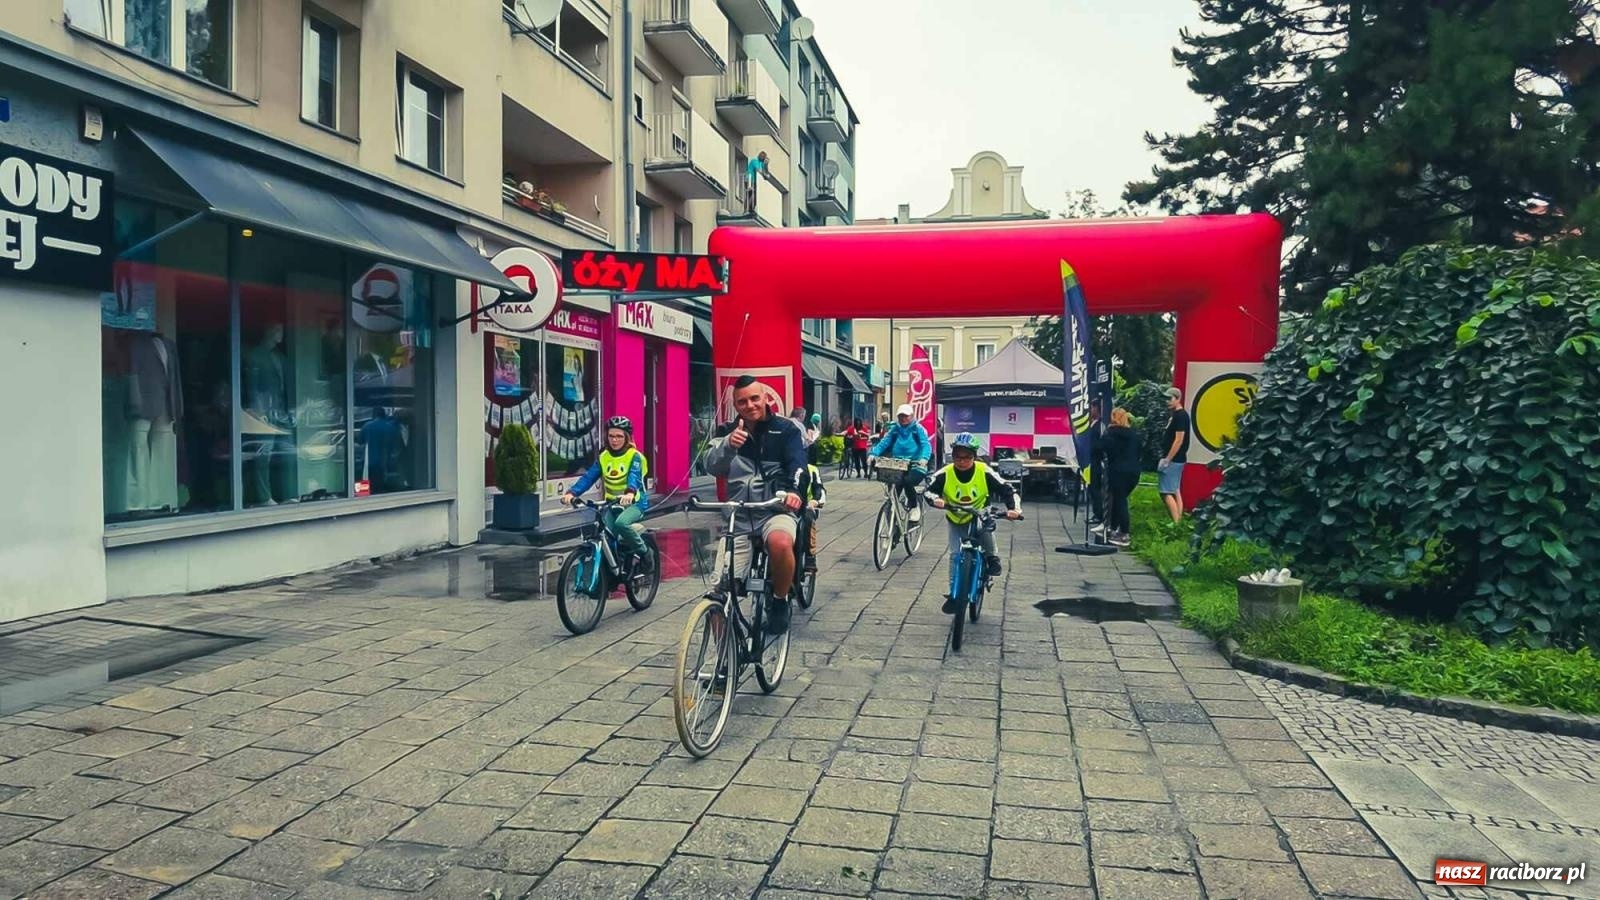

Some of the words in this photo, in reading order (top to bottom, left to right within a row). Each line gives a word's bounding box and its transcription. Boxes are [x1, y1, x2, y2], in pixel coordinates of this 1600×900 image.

[0, 157, 103, 221] ODY
[494, 303, 534, 314] ITAKA
[983, 388, 1047, 397] www.raciborz.pl
